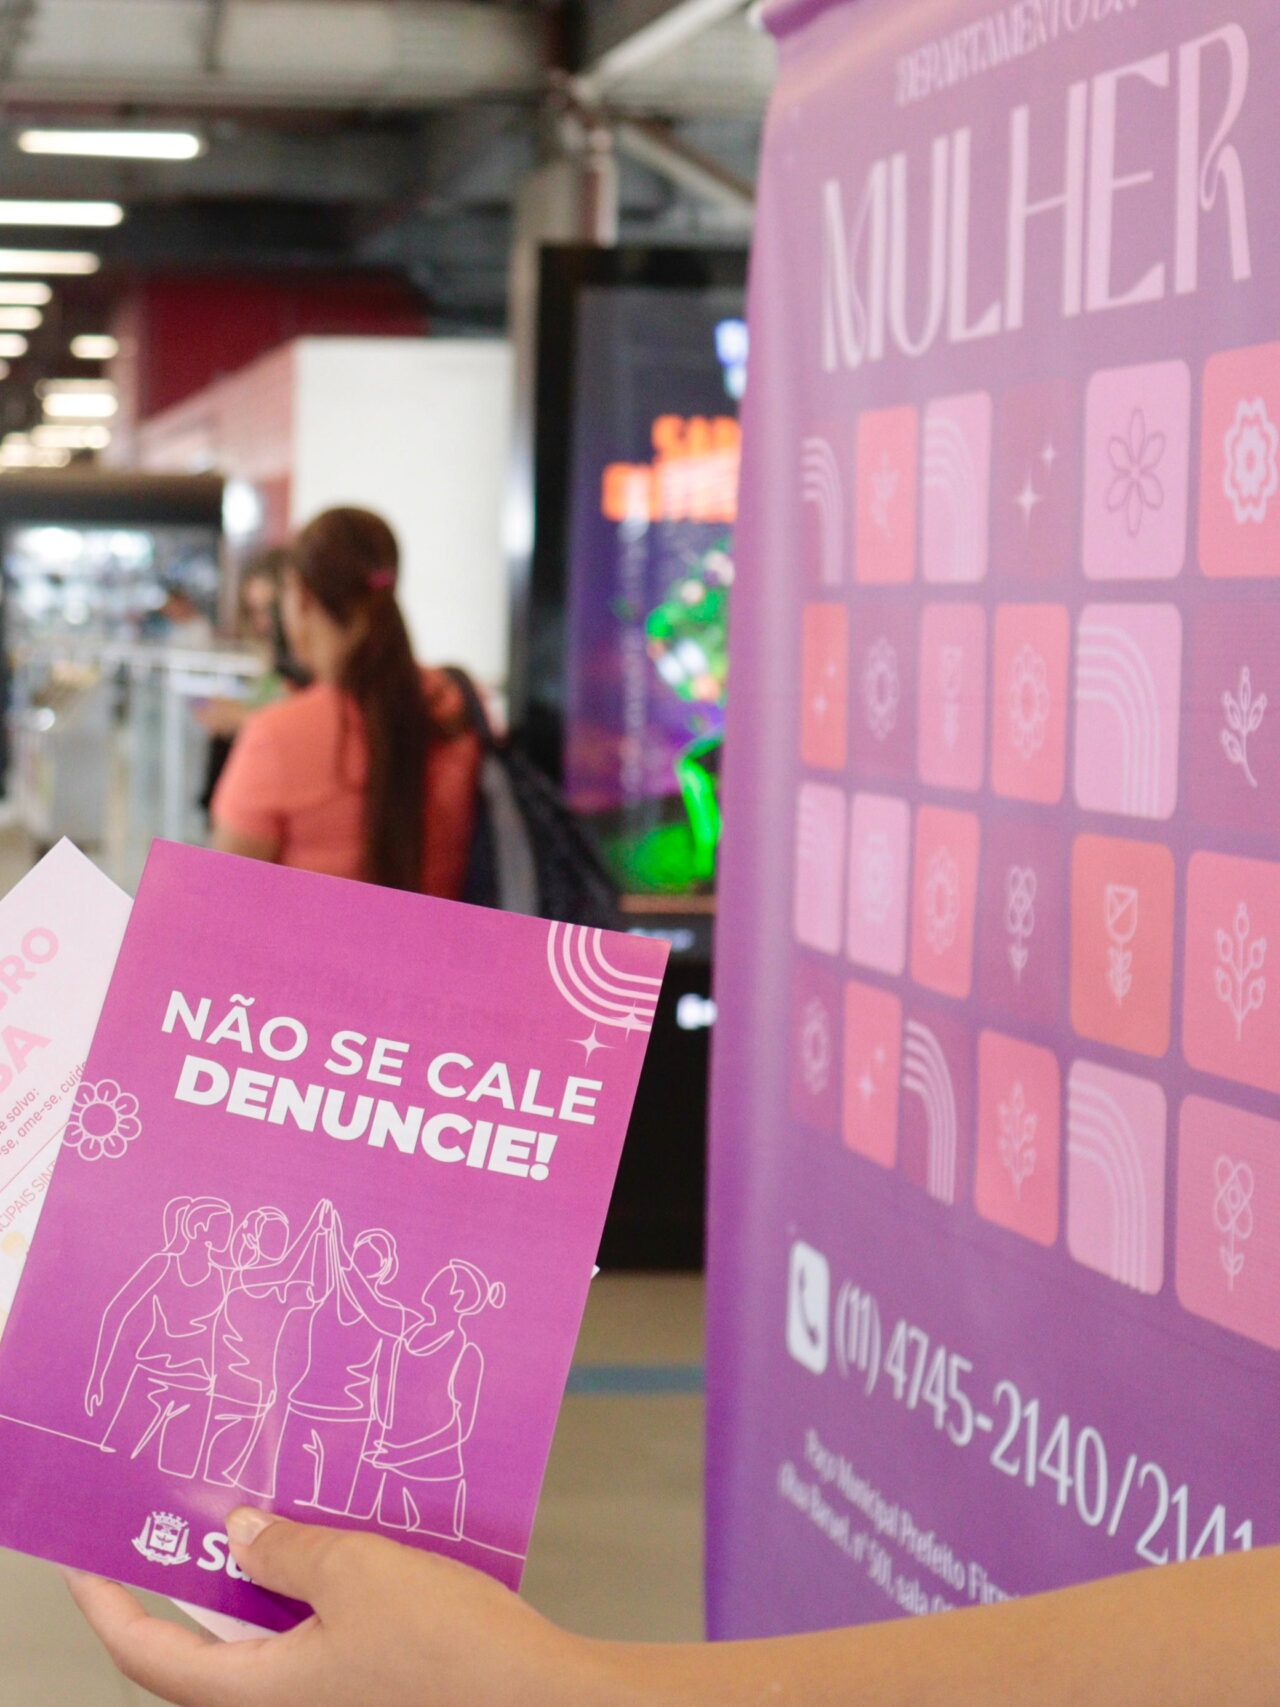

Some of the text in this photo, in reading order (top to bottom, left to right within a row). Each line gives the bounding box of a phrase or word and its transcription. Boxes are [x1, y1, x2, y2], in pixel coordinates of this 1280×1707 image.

[822, 22, 1251, 374] MULHER
[6, 1088, 40, 1123] salva:
[17, 1094, 63, 1138] ame-se,
[161, 990, 603, 1125] NÃO SE CALE
[174, 1054, 558, 1181] DENUNCIE!
[835, 1278, 881, 1396] (11)
